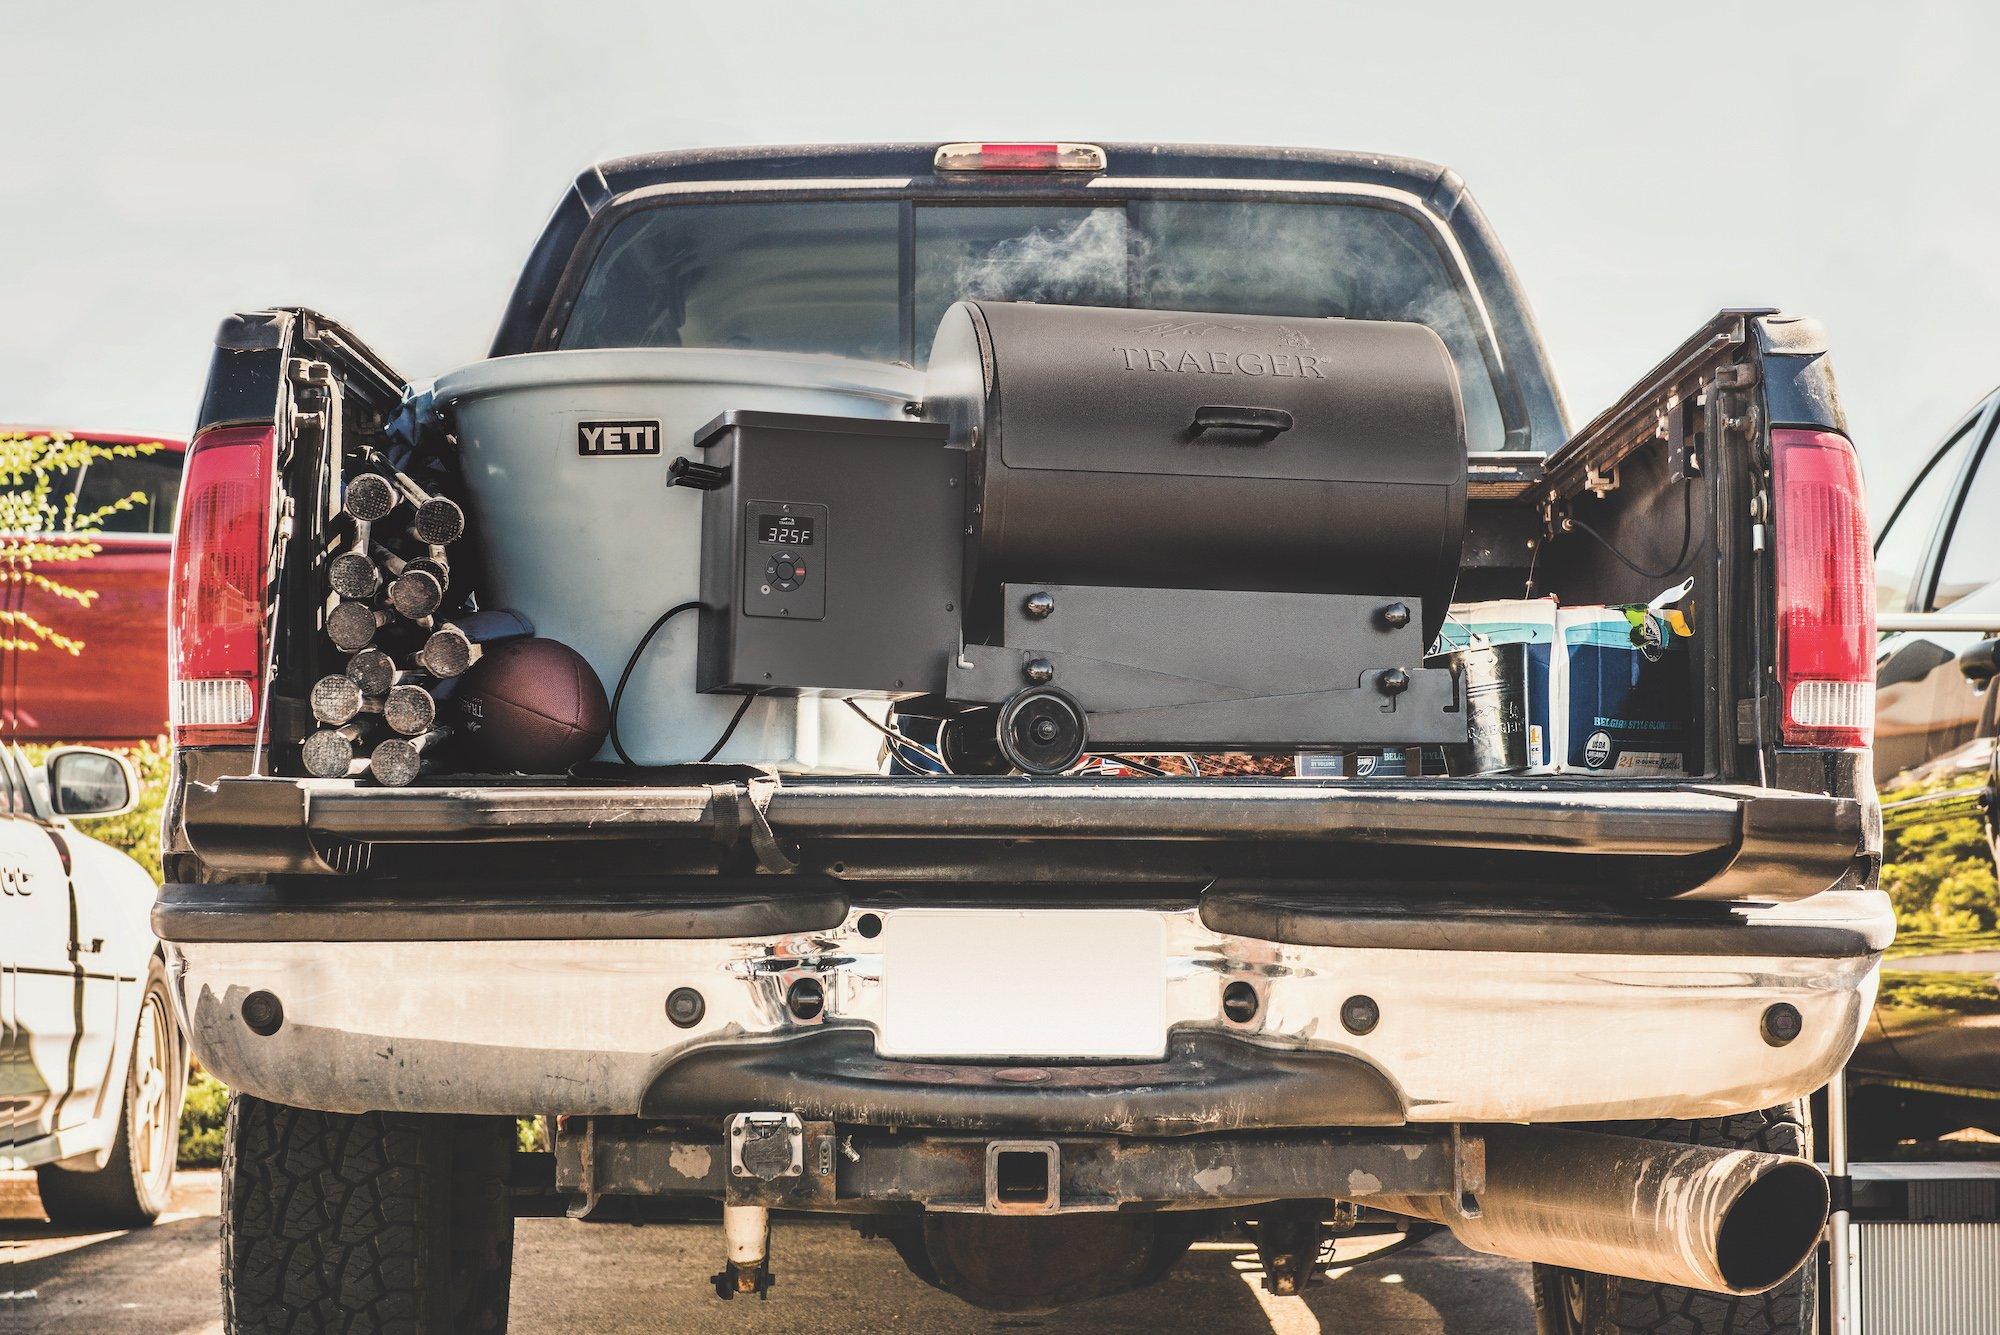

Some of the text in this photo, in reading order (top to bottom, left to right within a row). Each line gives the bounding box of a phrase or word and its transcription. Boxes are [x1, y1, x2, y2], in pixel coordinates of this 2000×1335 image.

[1112, 348, 1325, 379] TRAEGER
[581, 426, 654, 451] YETI
[768, 527, 811, 544] 325F
[1619, 756, 1633, 767] 24
